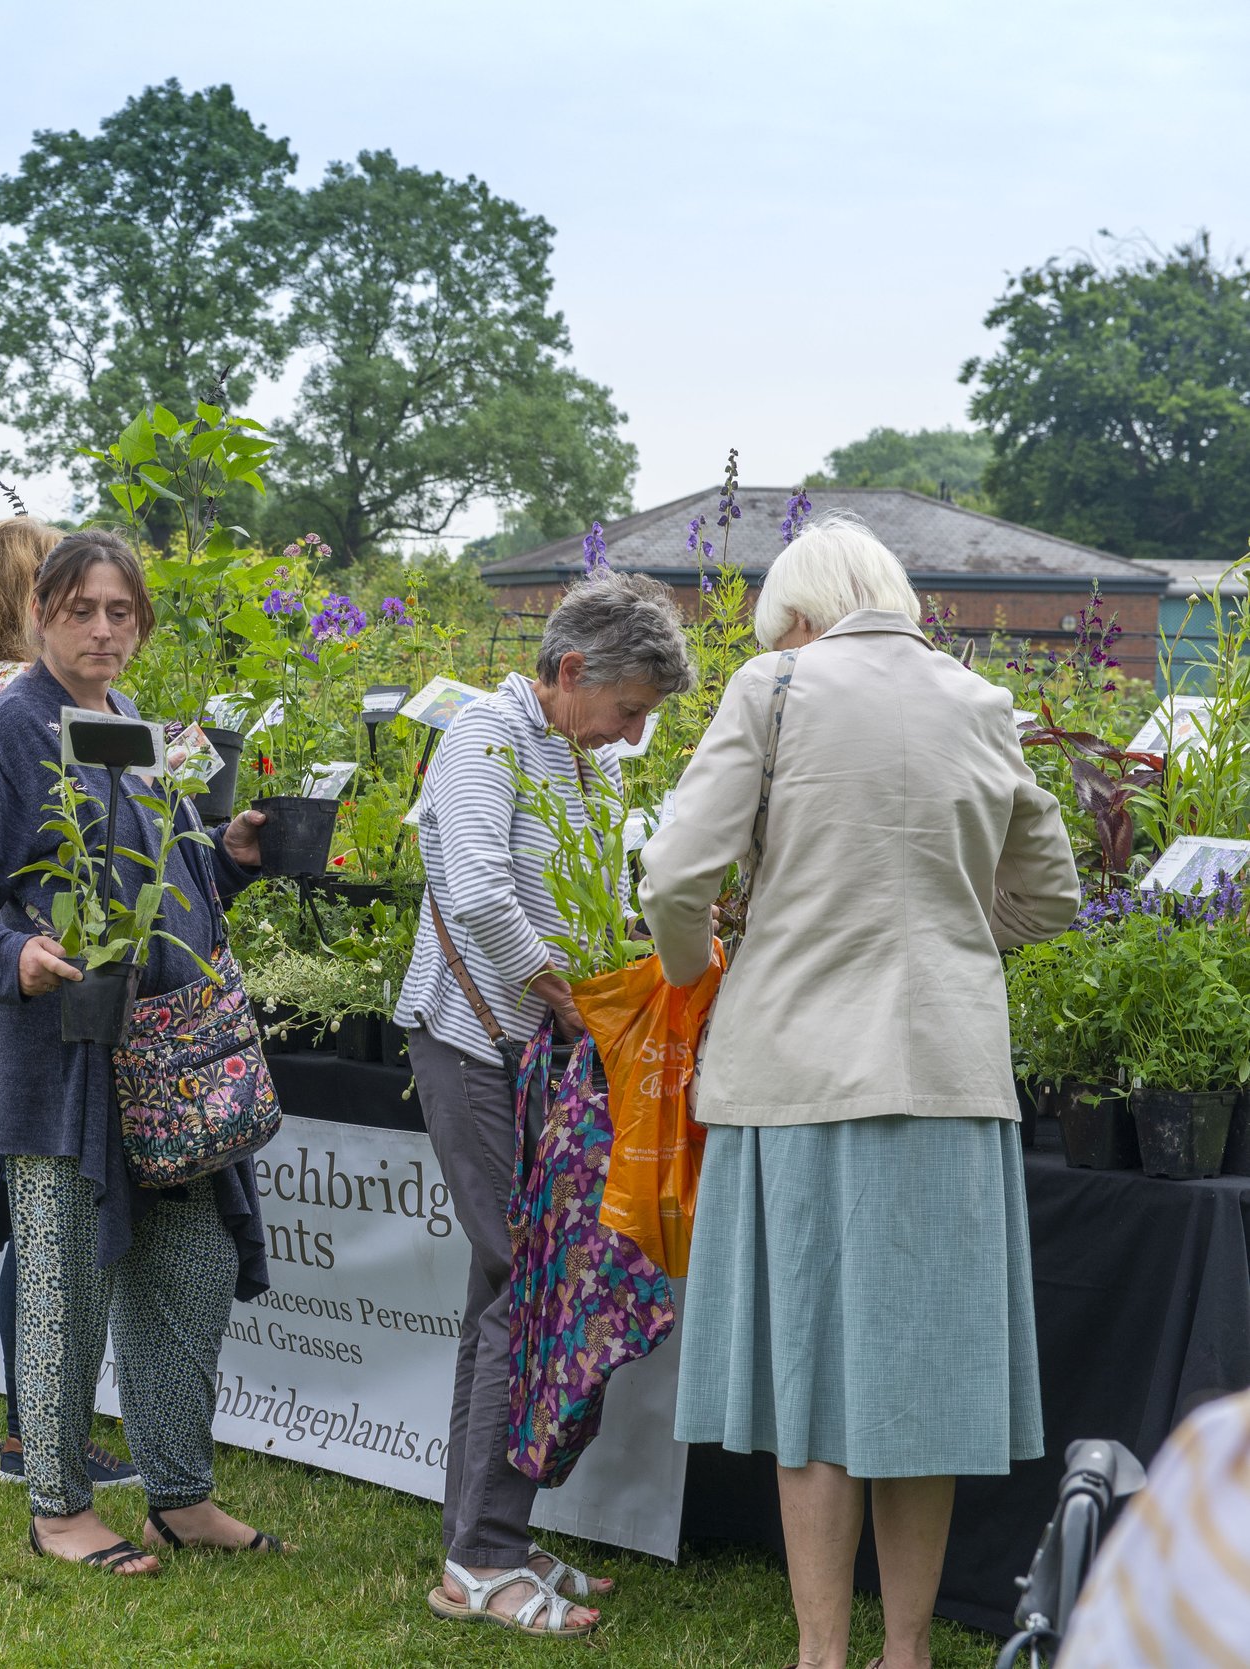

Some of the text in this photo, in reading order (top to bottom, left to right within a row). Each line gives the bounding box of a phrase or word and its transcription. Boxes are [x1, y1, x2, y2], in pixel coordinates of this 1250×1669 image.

[255, 1148, 452, 1237] echbridg
[266, 1219, 335, 1269] nts
[256, 1290, 462, 1338] baceous Perenni
[268, 1322, 363, 1364] Grasses
[216, 1371, 450, 1470] hbridgeplants.co
